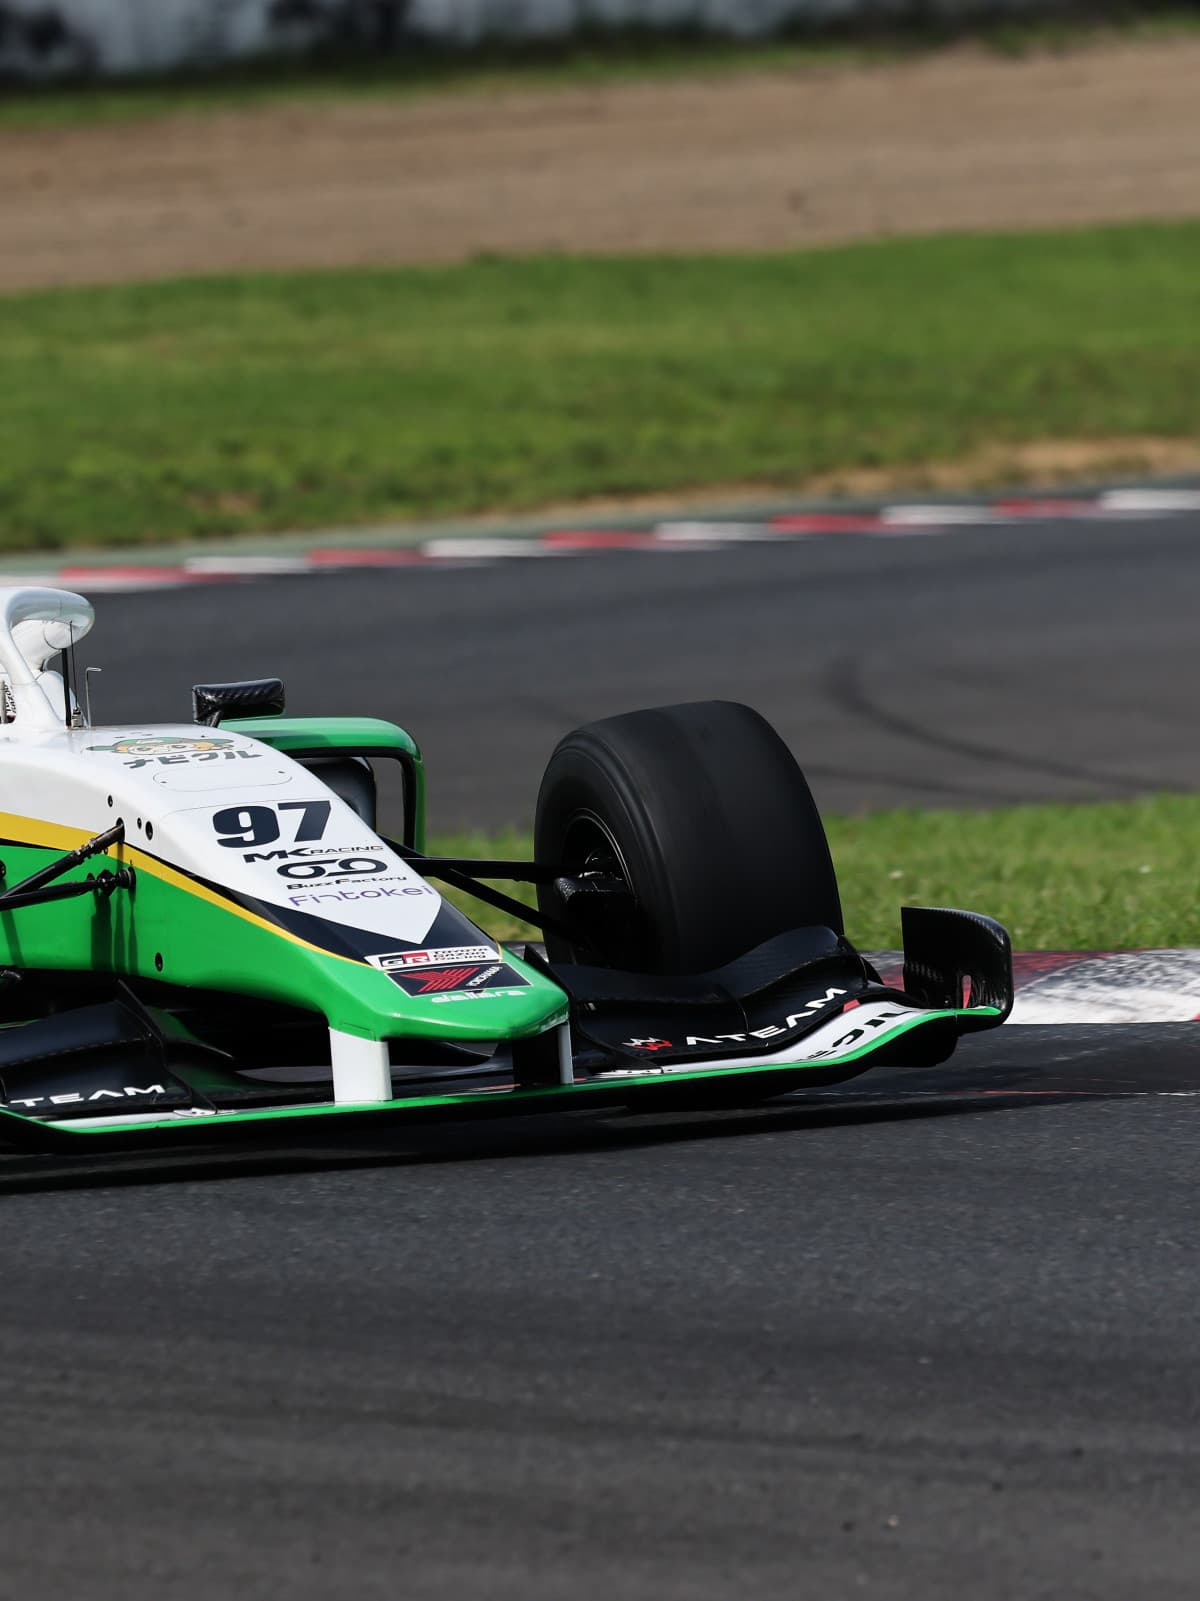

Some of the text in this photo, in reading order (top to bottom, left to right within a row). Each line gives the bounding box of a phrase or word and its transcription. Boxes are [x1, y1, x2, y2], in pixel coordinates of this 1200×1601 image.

[123, 750, 263, 769] ナビクル
[212, 800, 332, 848] 97
[288, 885, 434, 906] Fintokei
